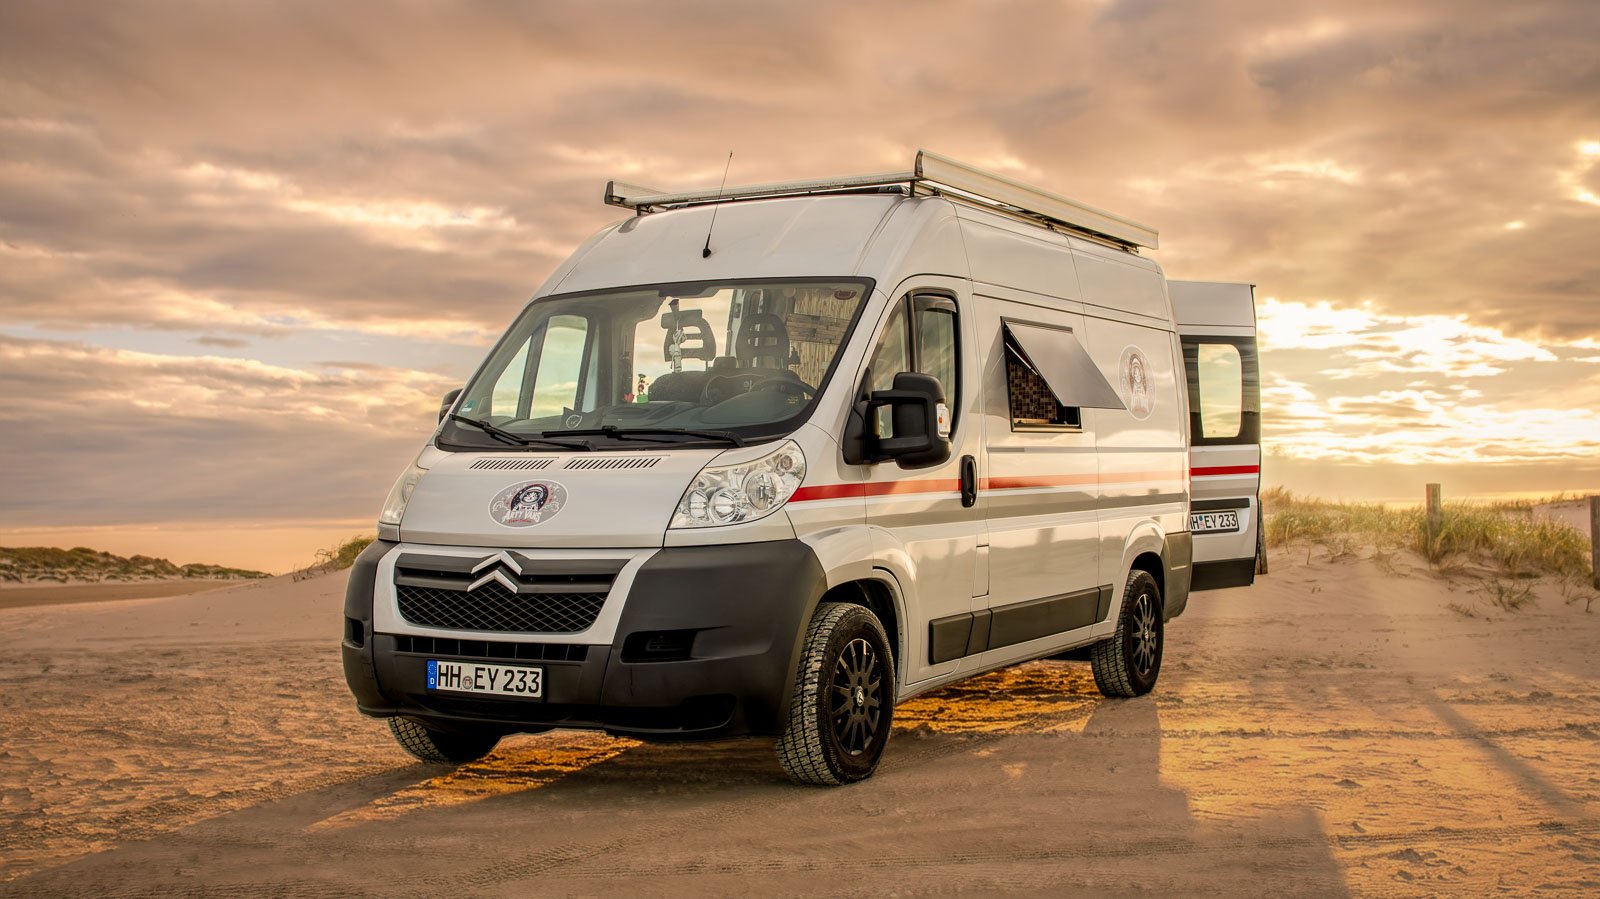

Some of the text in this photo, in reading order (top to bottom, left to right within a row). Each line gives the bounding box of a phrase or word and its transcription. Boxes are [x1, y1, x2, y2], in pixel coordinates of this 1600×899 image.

[524, 510, 542, 523] VANS
[1204, 515, 1216, 528] EY
[1218, 514, 1236, 527] 233
[438, 665, 540, 693] HH EY 233
